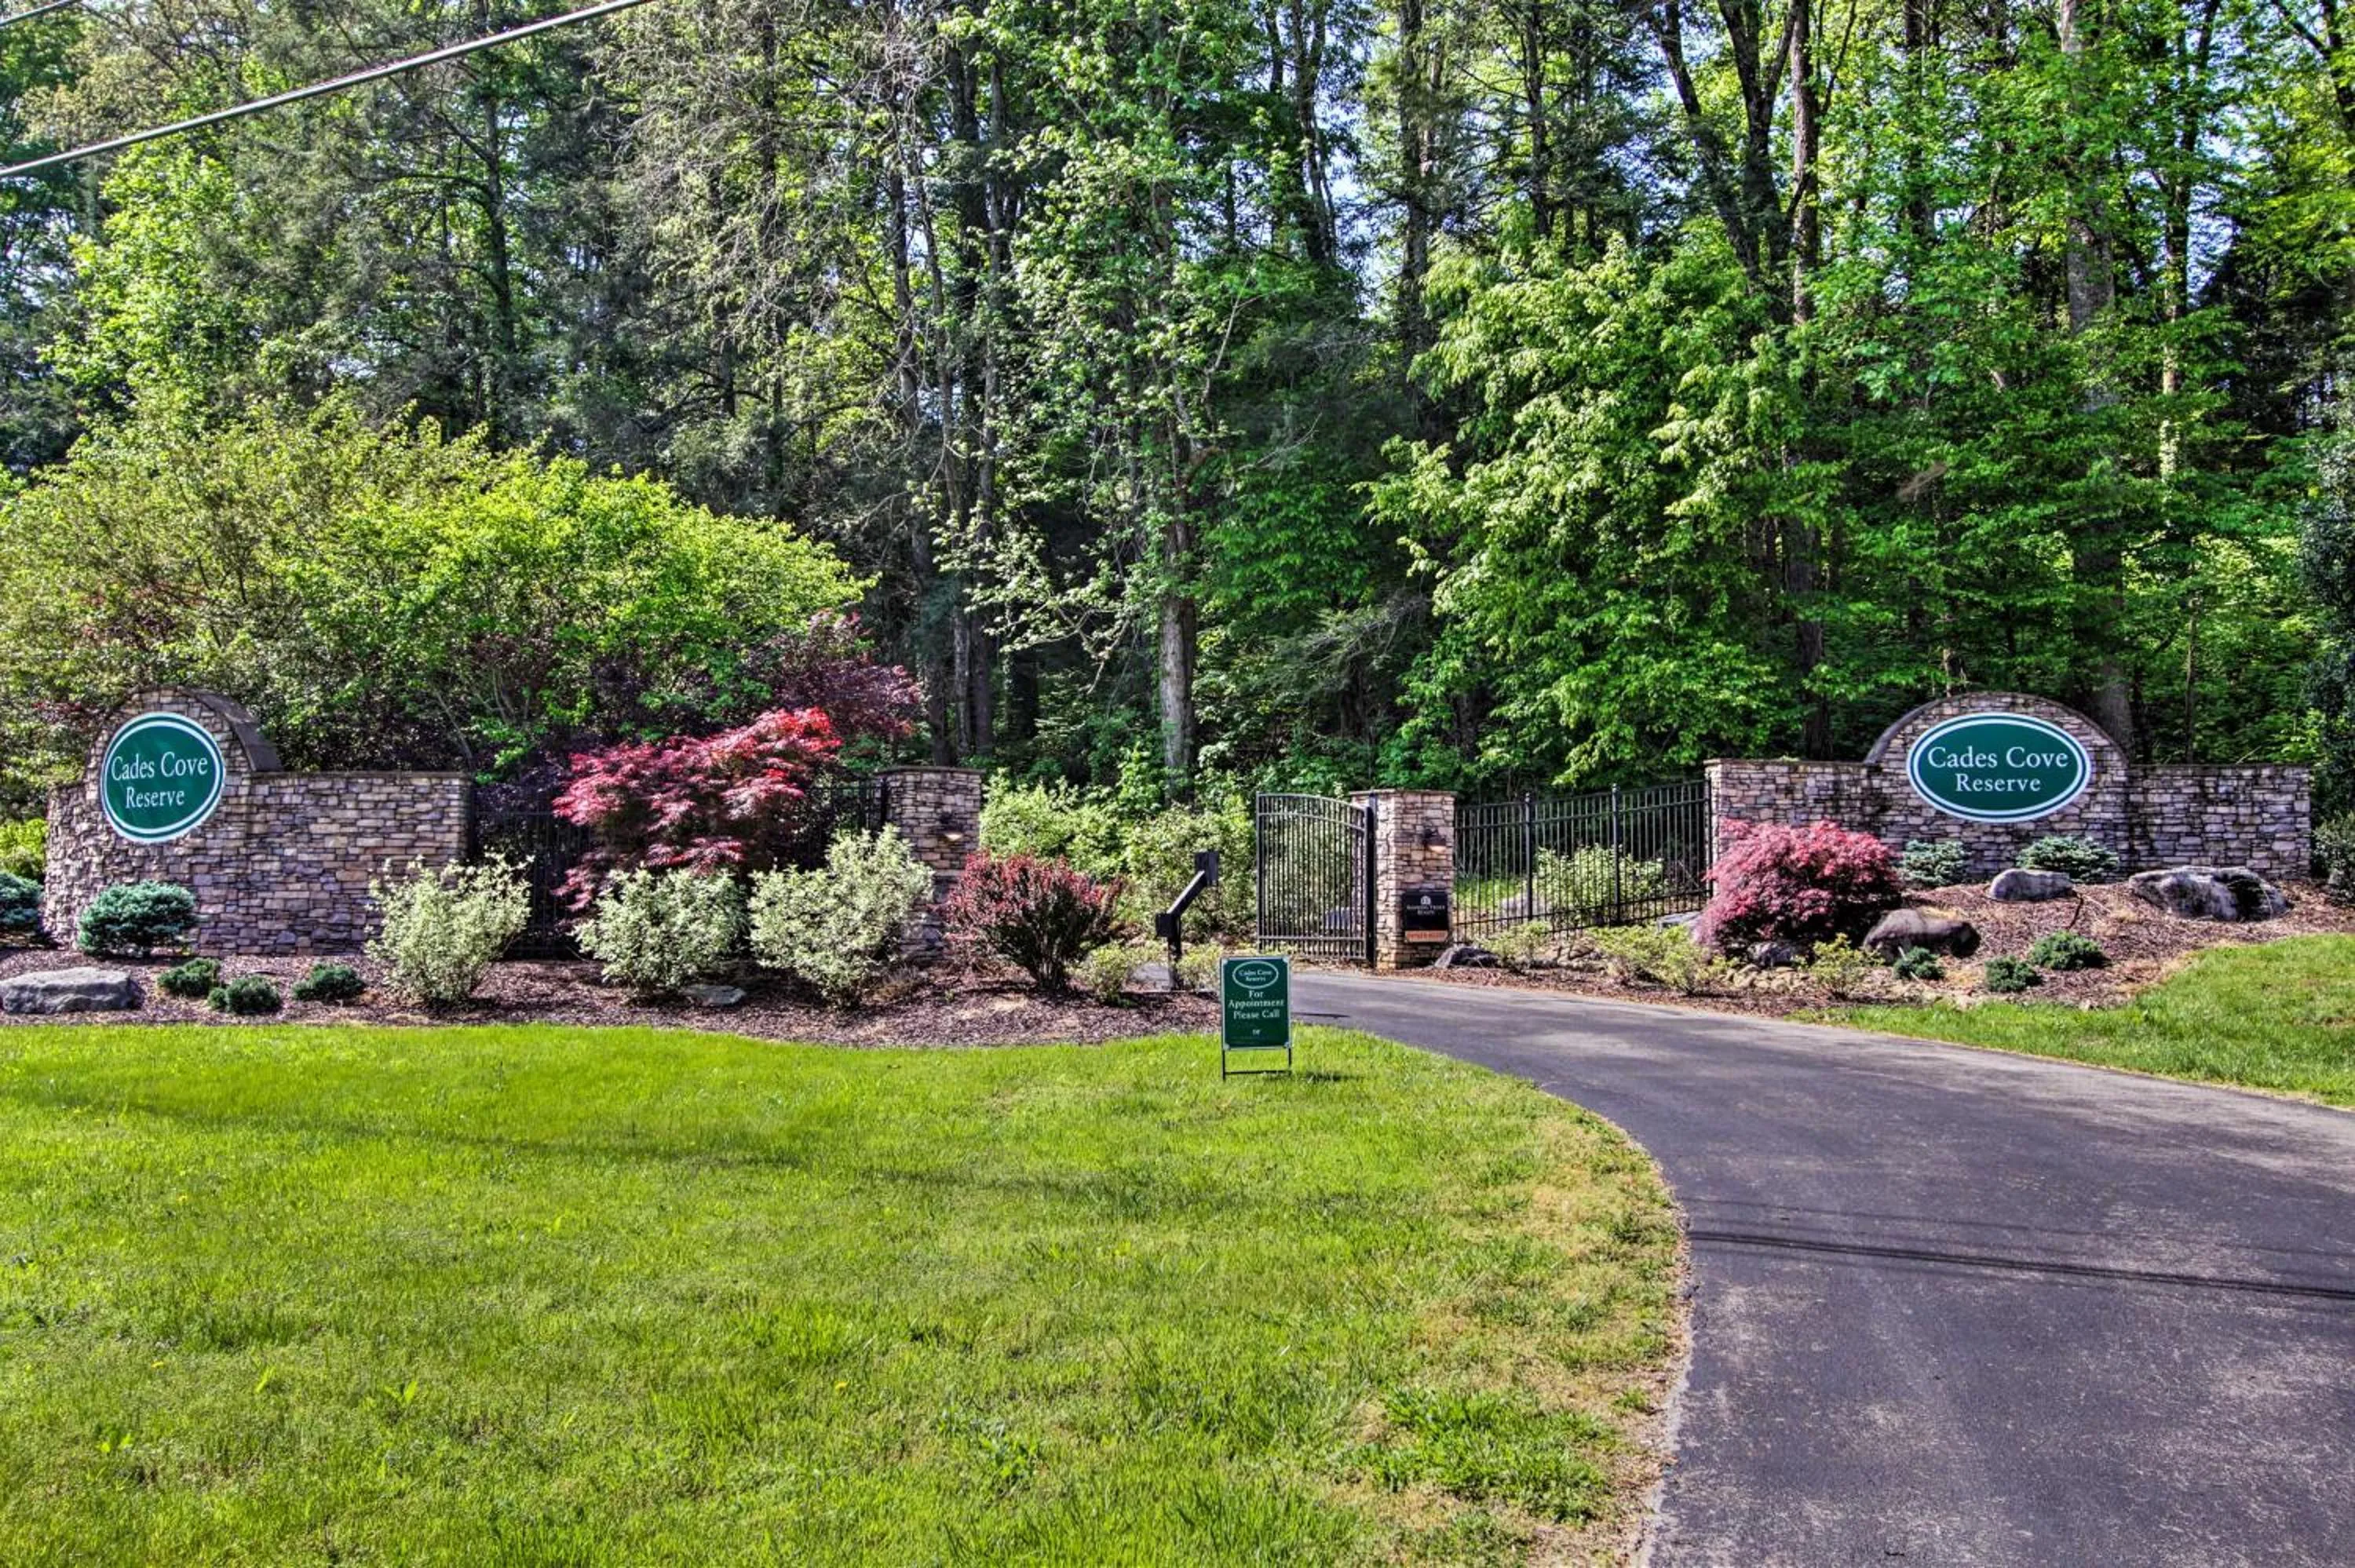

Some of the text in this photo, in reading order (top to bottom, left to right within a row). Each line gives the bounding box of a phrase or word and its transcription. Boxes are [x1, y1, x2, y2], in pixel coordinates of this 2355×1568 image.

[111, 751, 208, 781] Cades Cove
[1927, 746, 2068, 768] Cades Cove
[1955, 773, 2041, 792] Reserve
[125, 786, 184, 809] Reserve
[1229, 999, 1284, 1010] Appointment
[1233, 1008, 1280, 1020] Please Call
